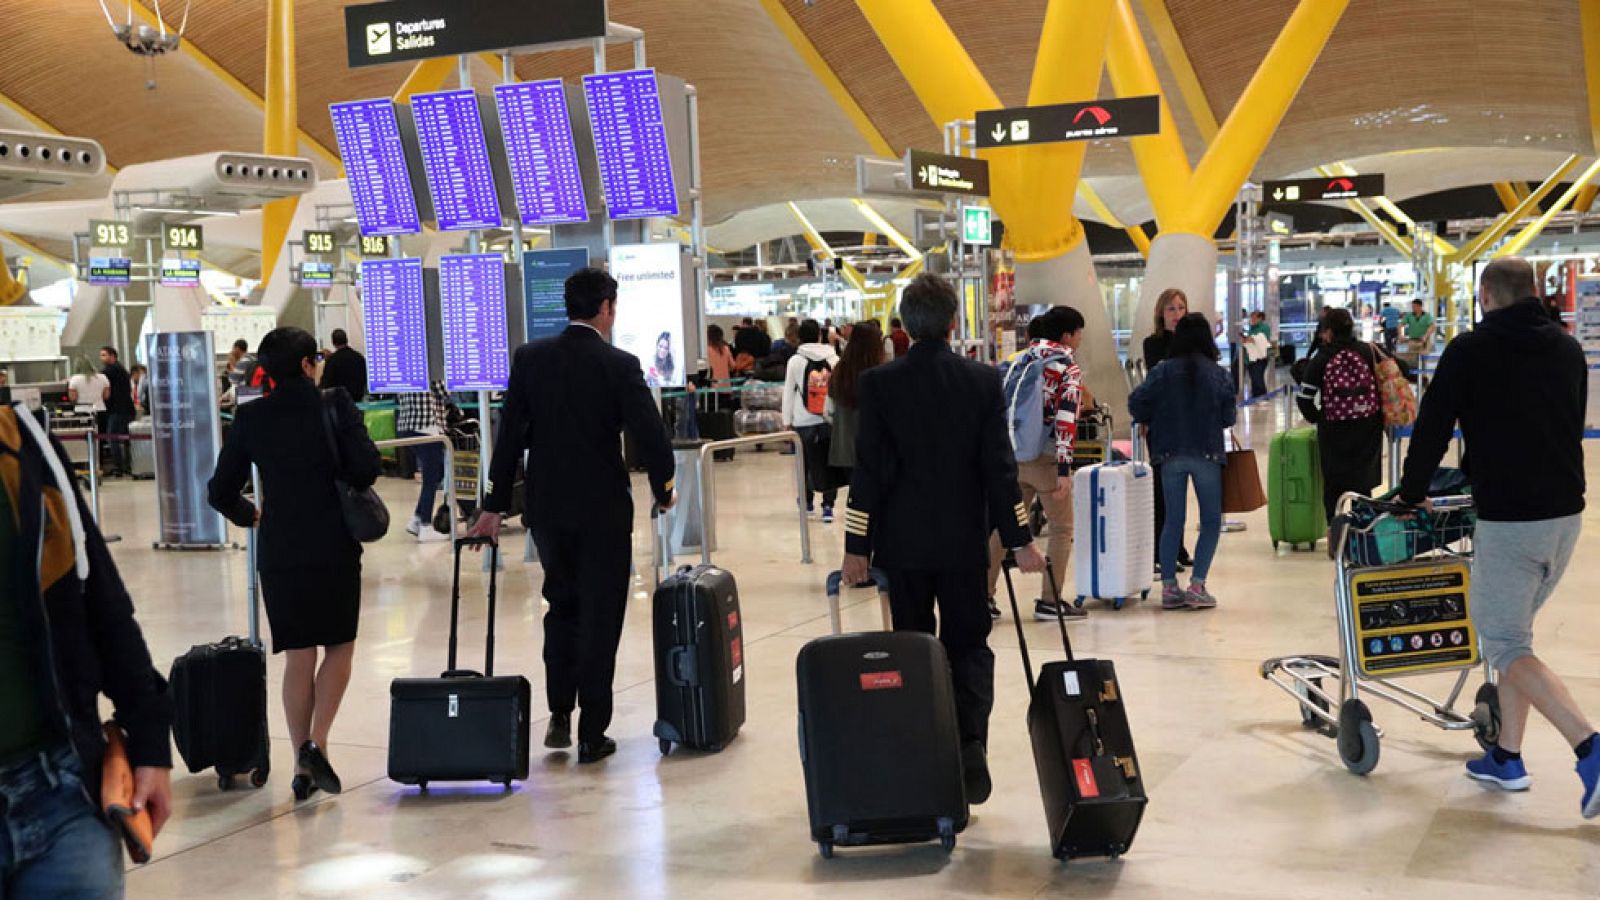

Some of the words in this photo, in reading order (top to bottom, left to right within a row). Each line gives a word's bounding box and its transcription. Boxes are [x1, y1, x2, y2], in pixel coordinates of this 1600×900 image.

[396, 18, 446, 36] Departures
[396, 34, 435, 50] Salidas
[97, 224, 129, 244] 913
[169, 228, 198, 248] 914
[309, 233, 332, 251] 915
[362, 236, 385, 253] 916
[616, 272, 635, 282] Free
[636, 270, 675, 282] unlimited
